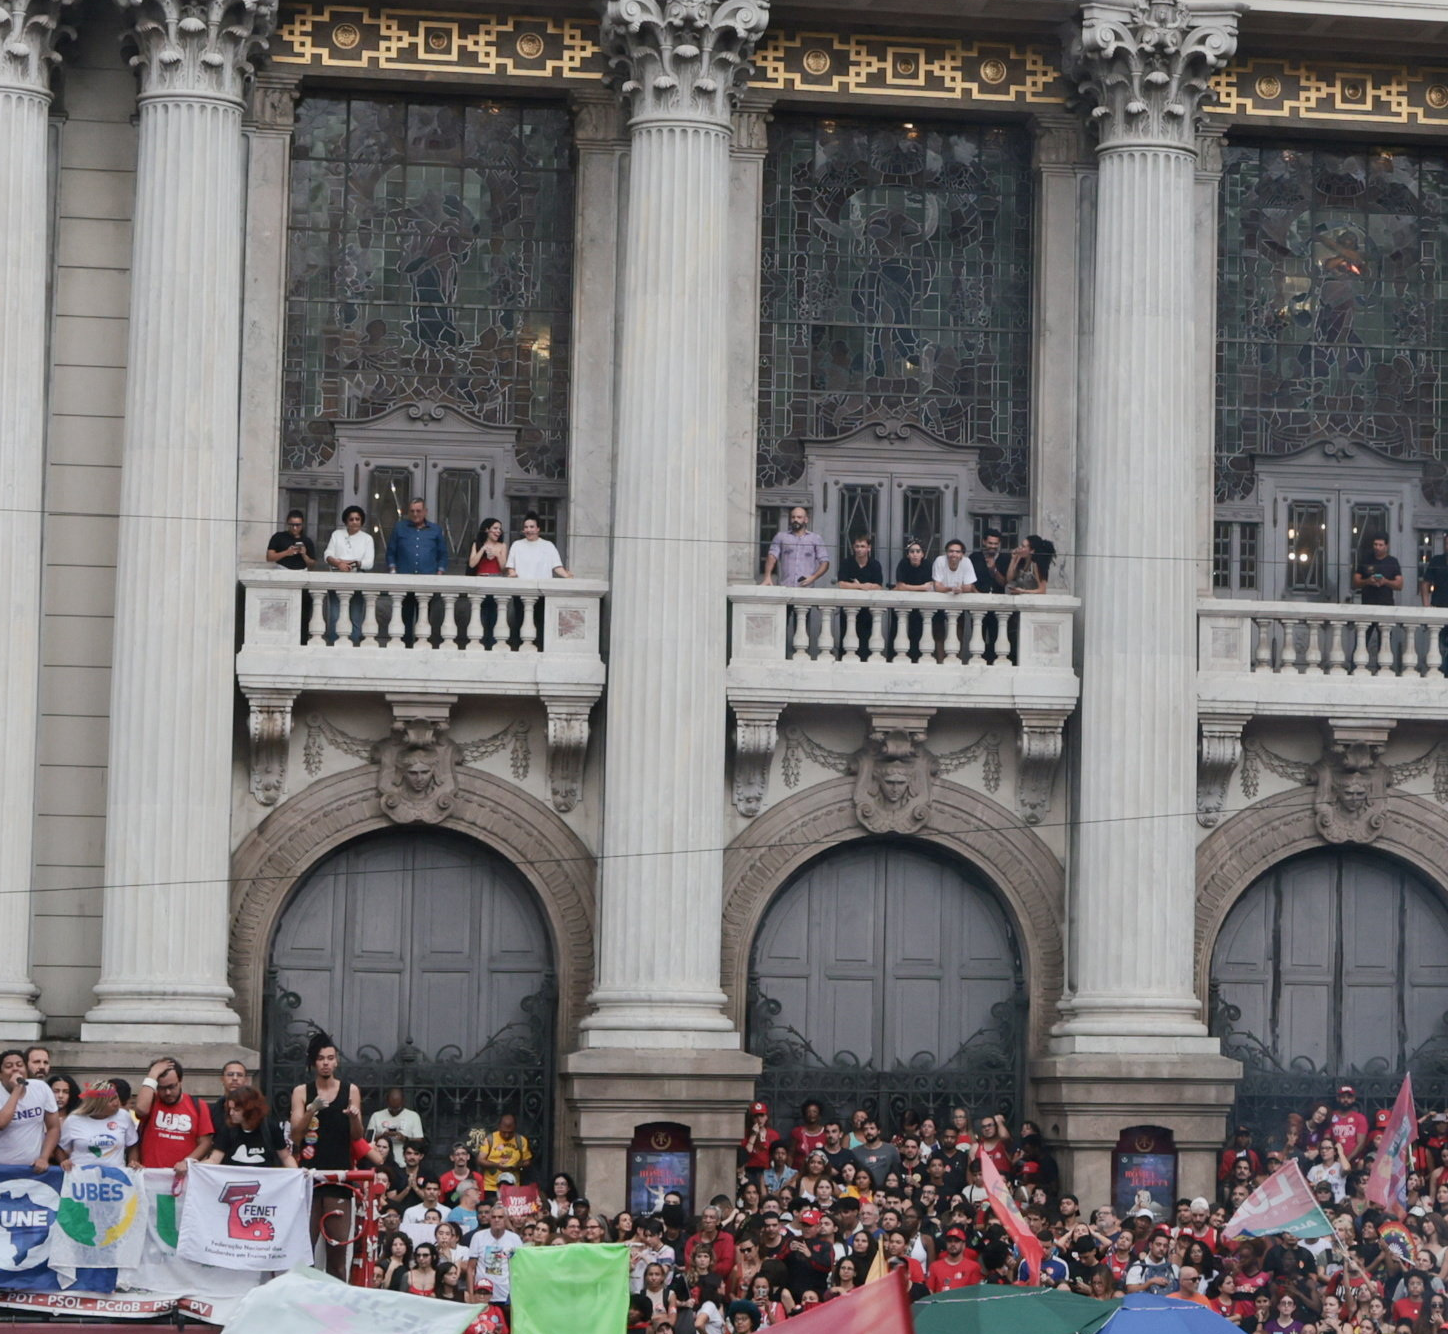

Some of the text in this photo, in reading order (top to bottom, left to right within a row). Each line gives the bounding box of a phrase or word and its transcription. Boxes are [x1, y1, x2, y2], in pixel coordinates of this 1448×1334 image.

[71, 1182, 125, 1202] UBES
[1, 1209, 48, 1228] UNE
[243, 1205, 277, 1217] FENET
[7, 1291, 36, 1304] PDT
[47, 1295, 82, 1308] PSOL
[96, 1299, 141, 1313] PCdoB
[189, 1300, 210, 1314] PV
